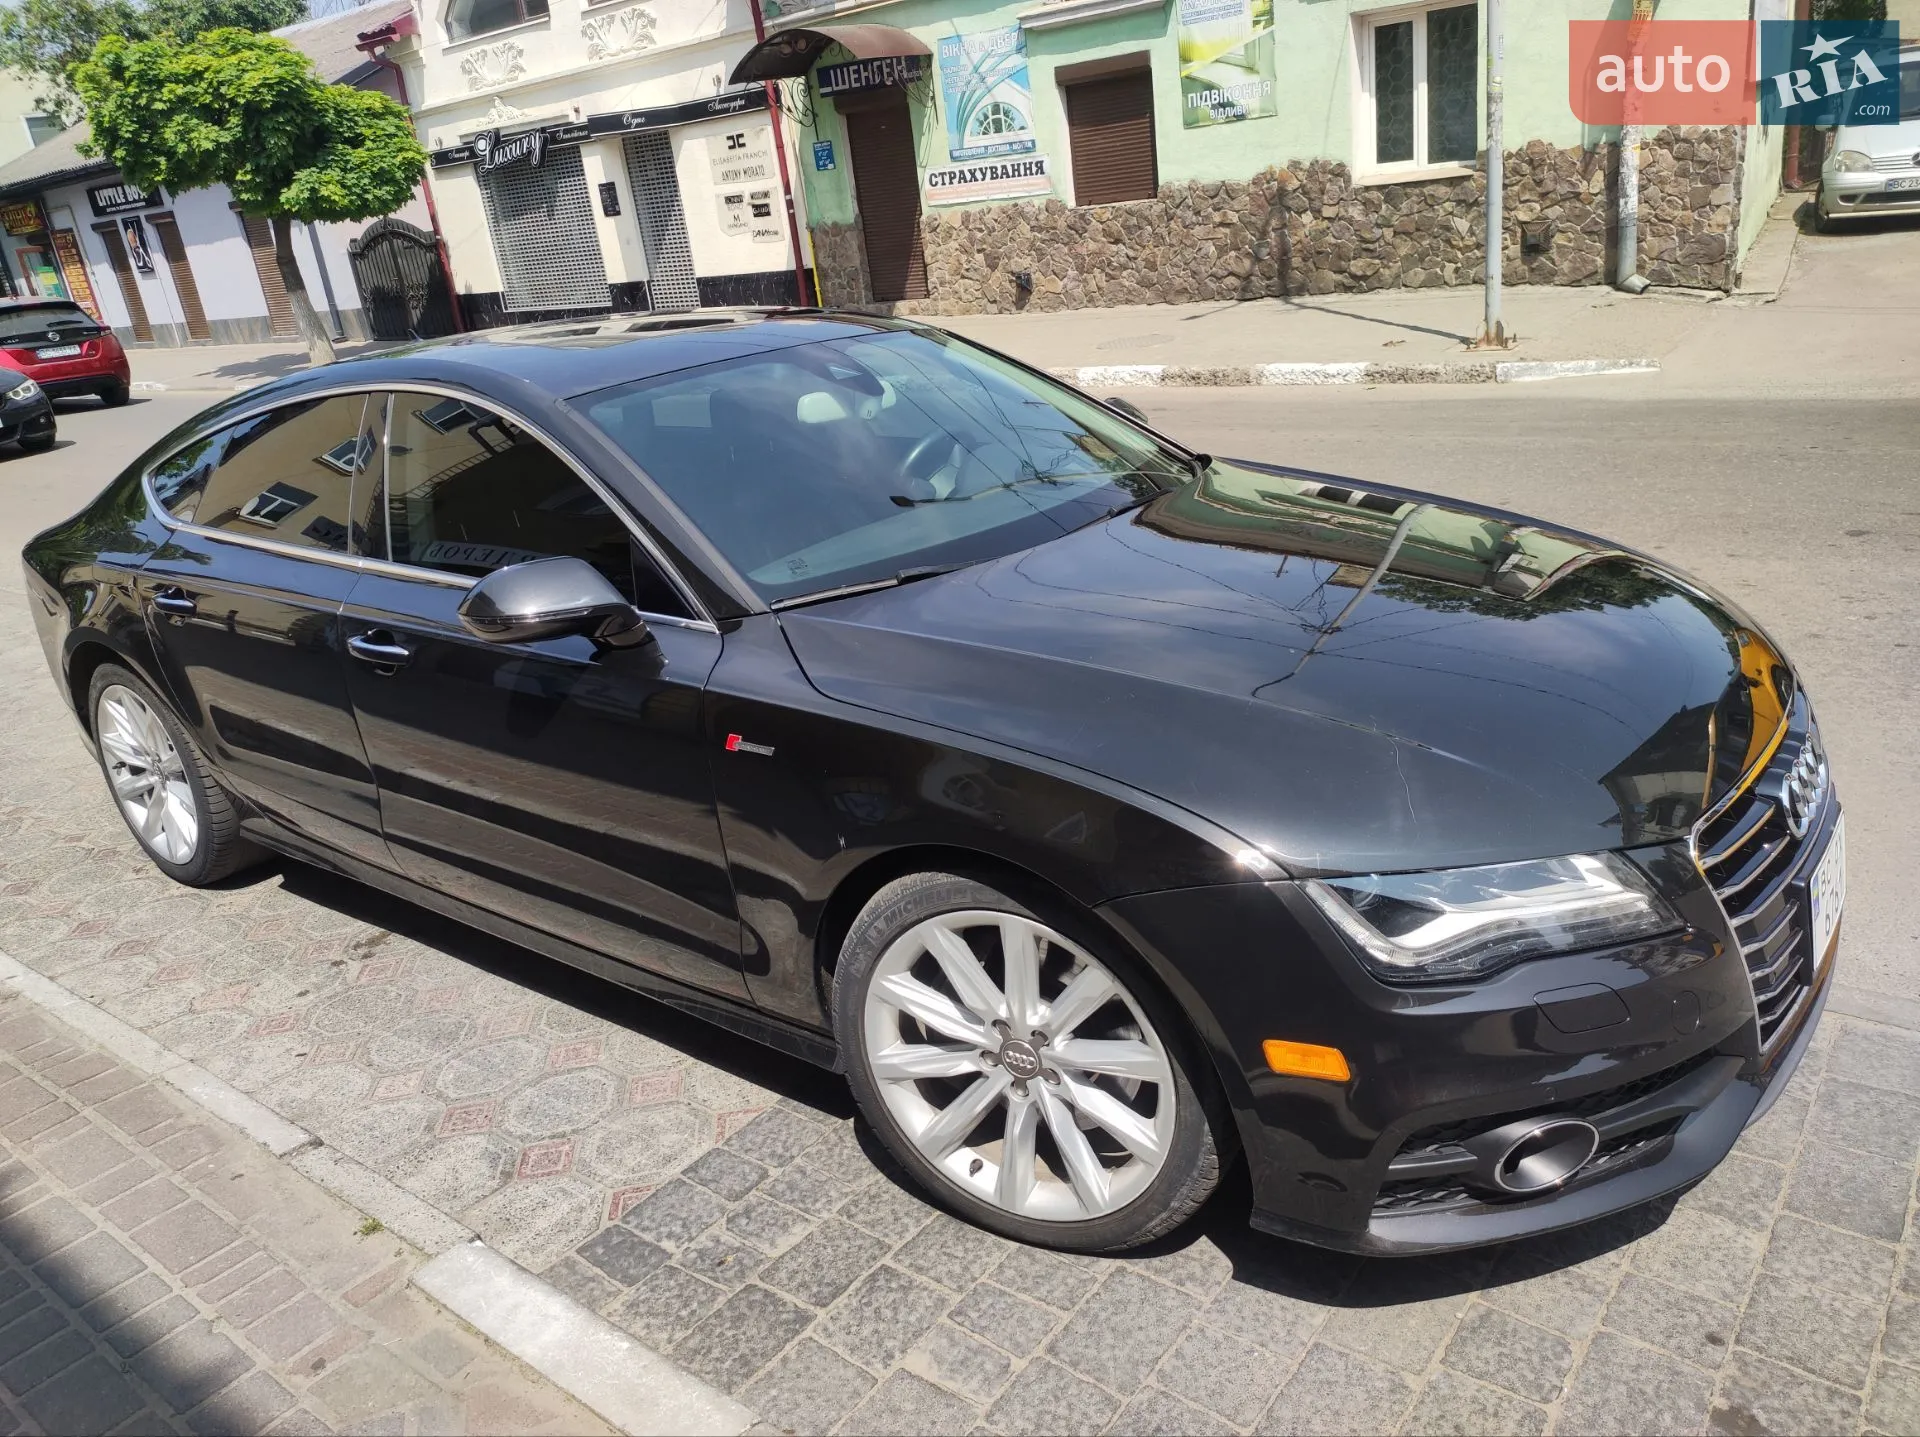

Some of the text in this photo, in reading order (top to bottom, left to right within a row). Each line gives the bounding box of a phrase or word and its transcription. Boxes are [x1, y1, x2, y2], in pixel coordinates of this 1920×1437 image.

[943, 40, 976, 58] ВІКНА
[1187, 80, 1271, 108] ПІДВІКОННЯ
[1210, 104, 1249, 120] ВІДЛИВИ
[475, 130, 543, 172] Luxury
[743, 150, 768, 160] FRANCHI
[722, 168, 741, 180] ANTONY
[929, 160, 1045, 187] СТРАХУВАННЯ
[94, 186, 125, 206] LITTLE
